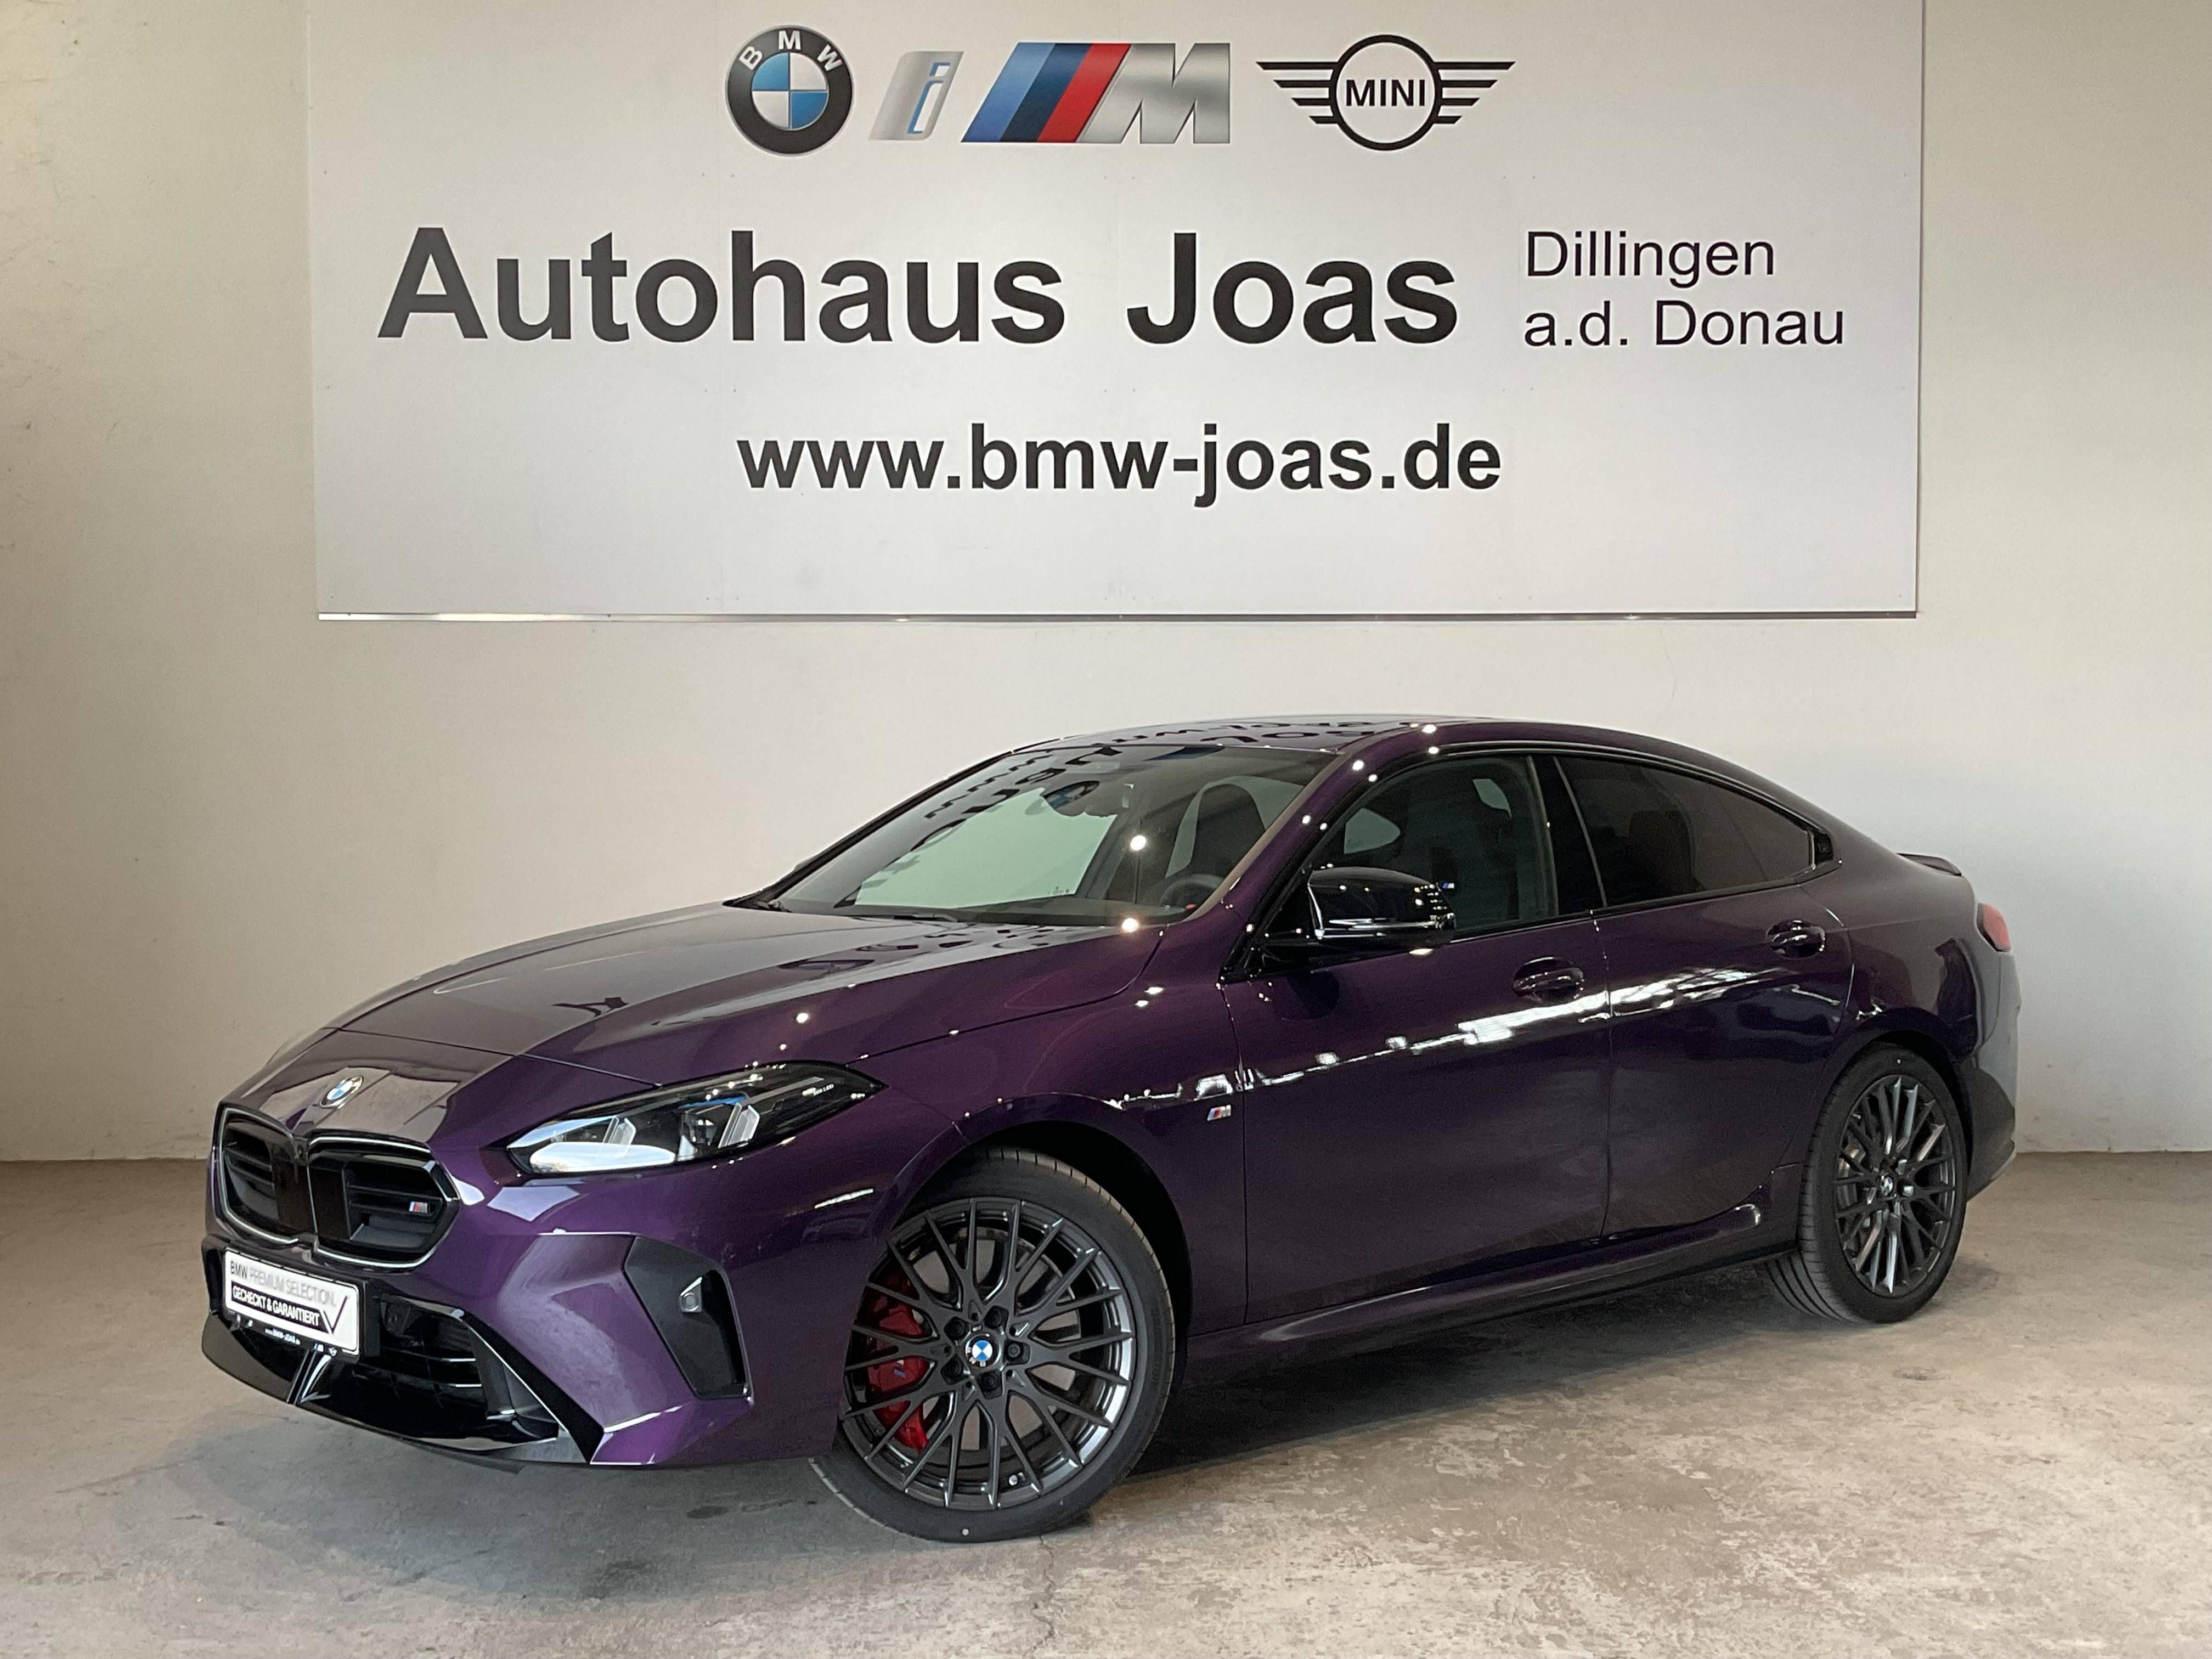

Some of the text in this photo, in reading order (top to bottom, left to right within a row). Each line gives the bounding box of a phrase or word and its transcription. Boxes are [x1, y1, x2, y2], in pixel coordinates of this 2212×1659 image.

[739, 30, 843, 72] BMW
[1081, 43, 1231, 144] M
[1346, 79, 1425, 107] MINI
[1528, 230, 1774, 289] Dillingen
[377, 227, 1457, 344] Autohaus Joas
[1525, 300, 1843, 347] a.d. Donau
[737, 423, 1500, 508] www.bmw-joas.de
[230, 1261, 248, 1279] BMW
[250, 1268, 284, 1291] PREMIUM
[233, 1285, 320, 1327] GECHECKT & GARANTIERT
